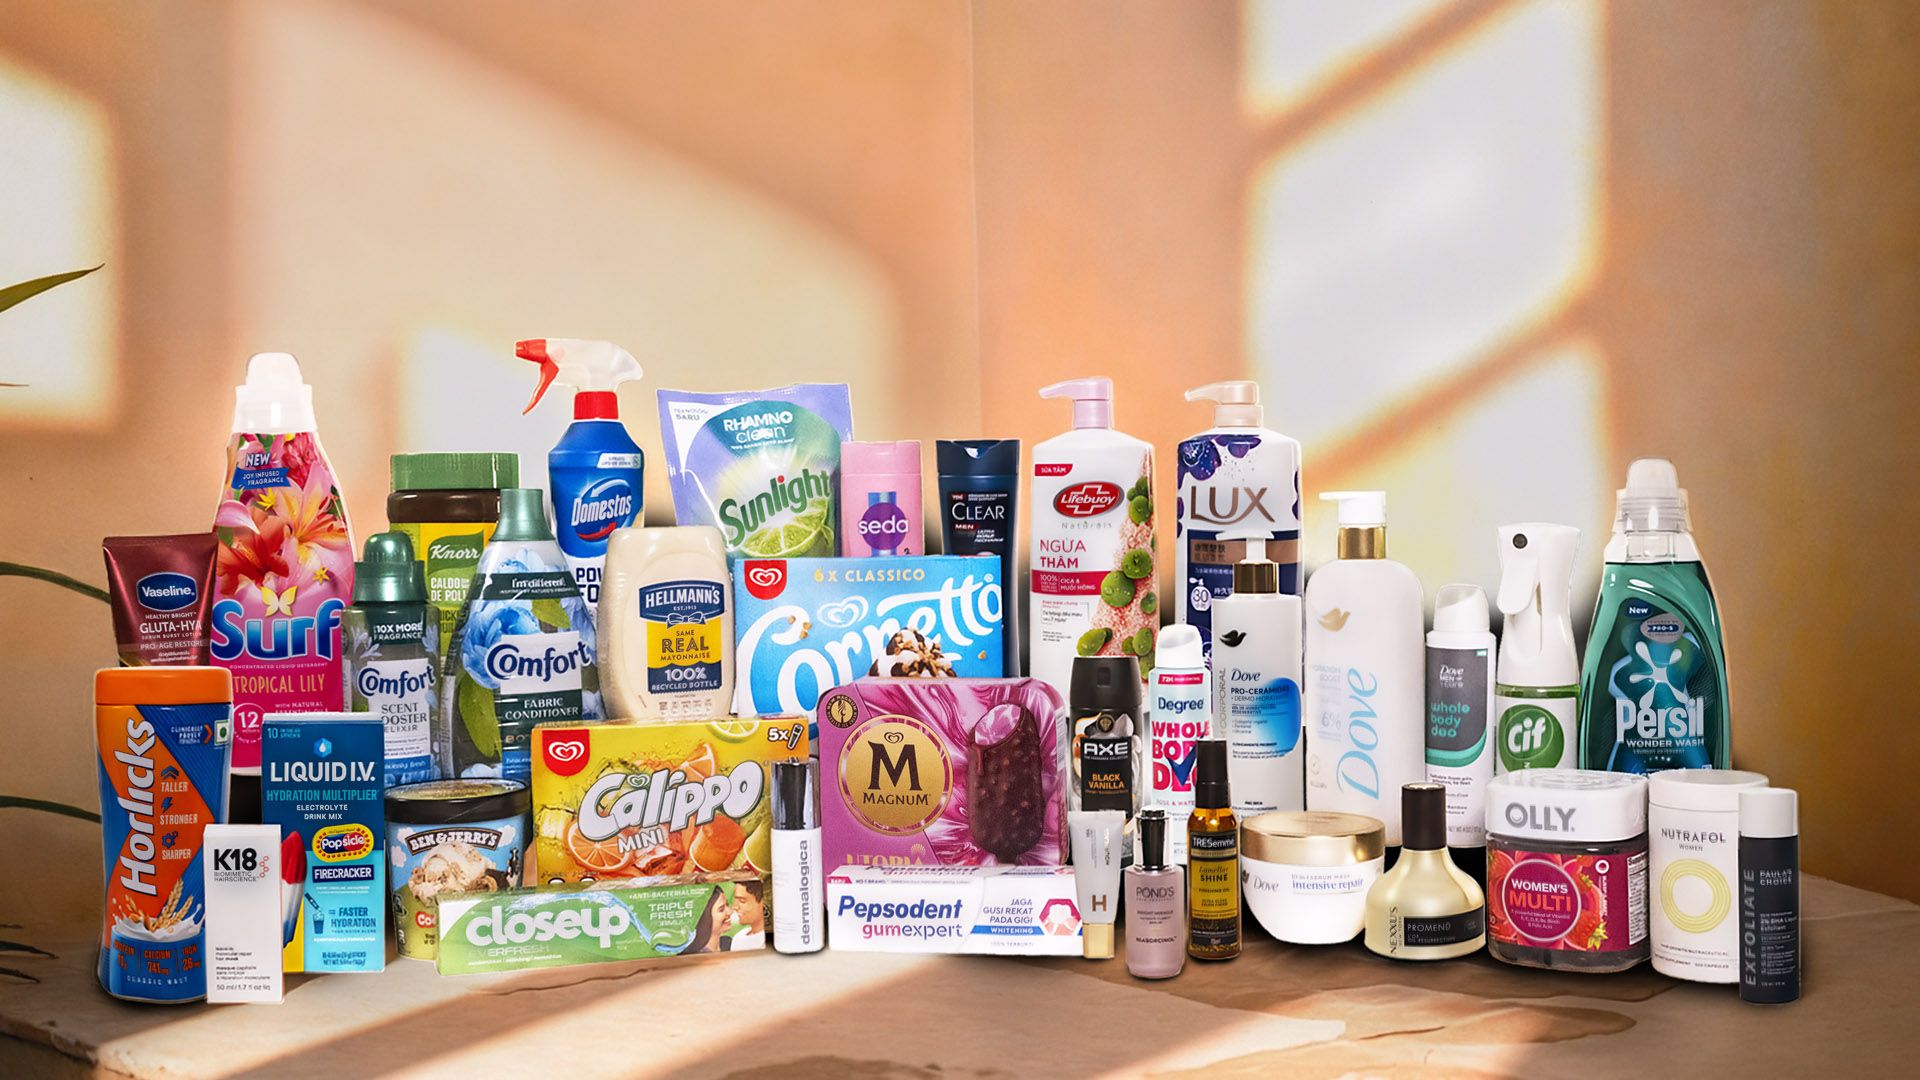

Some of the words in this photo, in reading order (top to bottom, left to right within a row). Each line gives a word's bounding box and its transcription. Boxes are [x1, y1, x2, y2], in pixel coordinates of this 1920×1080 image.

[723, 411, 793, 431] RHAMNO
[736, 426, 786, 443] clean
[245, 453, 270, 467] NEW
[243, 472, 254, 480] JOY
[255, 470, 280, 478] INFUSED
[248, 477, 284, 486] FRAGRANCE
[1060, 493, 1116, 505] Lifebuoy
[1190, 485, 1276, 525] LUX
[571, 494, 632, 527] Domestos
[719, 468, 831, 547] Sunlight
[952, 502, 1005, 520] CLEAR
[858, 515, 909, 535] seda
[1061, 521, 1112, 529] Naturals
[430, 544, 481, 559] Knorr
[576, 568, 602, 582] PO
[814, 568, 837, 582] 6X
[845, 568, 926, 582] CLASSICO
[430, 577, 460, 589] CALDO
[142, 586, 195, 597] Vaseline
[431, 590, 442, 600] DE
[645, 585, 720, 608] HELLMANN'S
[1193, 588, 1209, 603] 30
[139, 620, 202, 634] GLUTA-HYA
[209, 598, 346, 662] Surf
[376, 624, 394, 634] 10X
[396, 621, 423, 632] MORE
[374, 632, 422, 640] FRAGRANCE
[140, 641, 173, 650] PRO-AGE
[661, 636, 710, 653] REAL
[733, 575, 1003, 722] Cornetto
[486, 641, 590, 682] Comfort
[660, 652, 711, 661] MAYONNAISE
[665, 667, 707, 682] 100%
[1230, 667, 1260, 681] Dove
[232, 676, 294, 693] TROPICAL
[300, 673, 325, 692] LILY
[358, 665, 435, 698] Comfort
[652, 683, 688, 691] RECYCLED
[689, 680, 718, 688] BOTTLE
[381, 702, 418, 714] SCENT
[524, 697, 564, 709] FABRIC
[1158, 697, 1204, 714] Degree
[1430, 702, 1470, 713] whole
[238, 711, 260, 728] 12
[381, 712, 427, 725] OOSTER
[505, 707, 579, 720] CONDITIONER
[1616, 697, 1705, 742] Persil
[1322, 712, 1341, 730] 6%
[1430, 714, 1461, 728] body
[267, 728, 278, 739] 10
[384, 725, 418, 733] ELIXIR
[768, 727, 788, 742] 5x
[1335, 667, 1379, 800] Dove
[1431, 726, 1457, 738] deo
[1508, 717, 1546, 753] cif
[1084, 742, 1128, 756] AXE
[1626, 739, 1673, 749] WONDER
[1675, 738, 1705, 748] WASH
[270, 762, 347, 782] LIQUID
[351, 762, 376, 782] I.V.
[868, 740, 922, 791] M
[1092, 773, 1120, 782] BLACK
[1153, 762, 1197, 792] DE
[161, 782, 188, 792] TALLER
[1088, 781, 1125, 790] VANILLA
[266, 789, 320, 801] HYDRATION
[322, 789, 378, 801] MULTIPLIER
[578, 760, 765, 842] Calippo
[862, 792, 929, 806] MAGNUM
[114, 718, 158, 896] Horlicks
[160, 814, 198, 825] STRONGER
[1505, 802, 1576, 832] OLLY
[321, 833, 365, 850] Popsicle
[409, 835, 436, 850] BEN
[436, 832, 447, 846] &
[447, 831, 498, 847] JERRY'S
[616, 827, 664, 854] MINI
[1661, 827, 1727, 844] NUTRAFOL
[162, 849, 192, 860] SHARPER
[1679, 843, 1704, 852] WOMEN
[214, 848, 258, 871] K18
[314, 868, 372, 879] FIRECRACKER
[1760, 869, 1793, 878] PAULA'S
[1253, 877, 1279, 892] Dove
[1292, 880, 1337, 890] intensive
[1338, 879, 1363, 891] repair
[1511, 878, 1568, 894] WOMEN'S
[1760, 877, 1793, 886] CHOICE
[799, 839, 810, 945] dermalogica
[1136, 886, 1175, 898] POND'S
[648, 901, 694, 911] TRIPLE
[1092, 895, 1106, 912] H
[1509, 889, 1572, 912] MULTI
[339, 907, 368, 917] FASTER
[650, 910, 693, 920] FRESH
[838, 895, 962, 922] Pepsodent
[983, 907, 1004, 915] GUSI
[1005, 907, 1033, 915] REKAT
[331, 918, 377, 927] HYDRATION
[466, 904, 630, 948] closeup
[1014, 916, 1033, 924] GIGI
[1407, 922, 1451, 932] PROMEND
[1743, 869, 1757, 985] EXFOLIATE
[862, 924, 963, 940] gumexpert
[1389, 906, 1398, 953] NEXXUS
[144, 949, 171, 959] CALCIUM
[127, 975, 162, 985] CLASSIC
[167, 976, 188, 985] MALT
